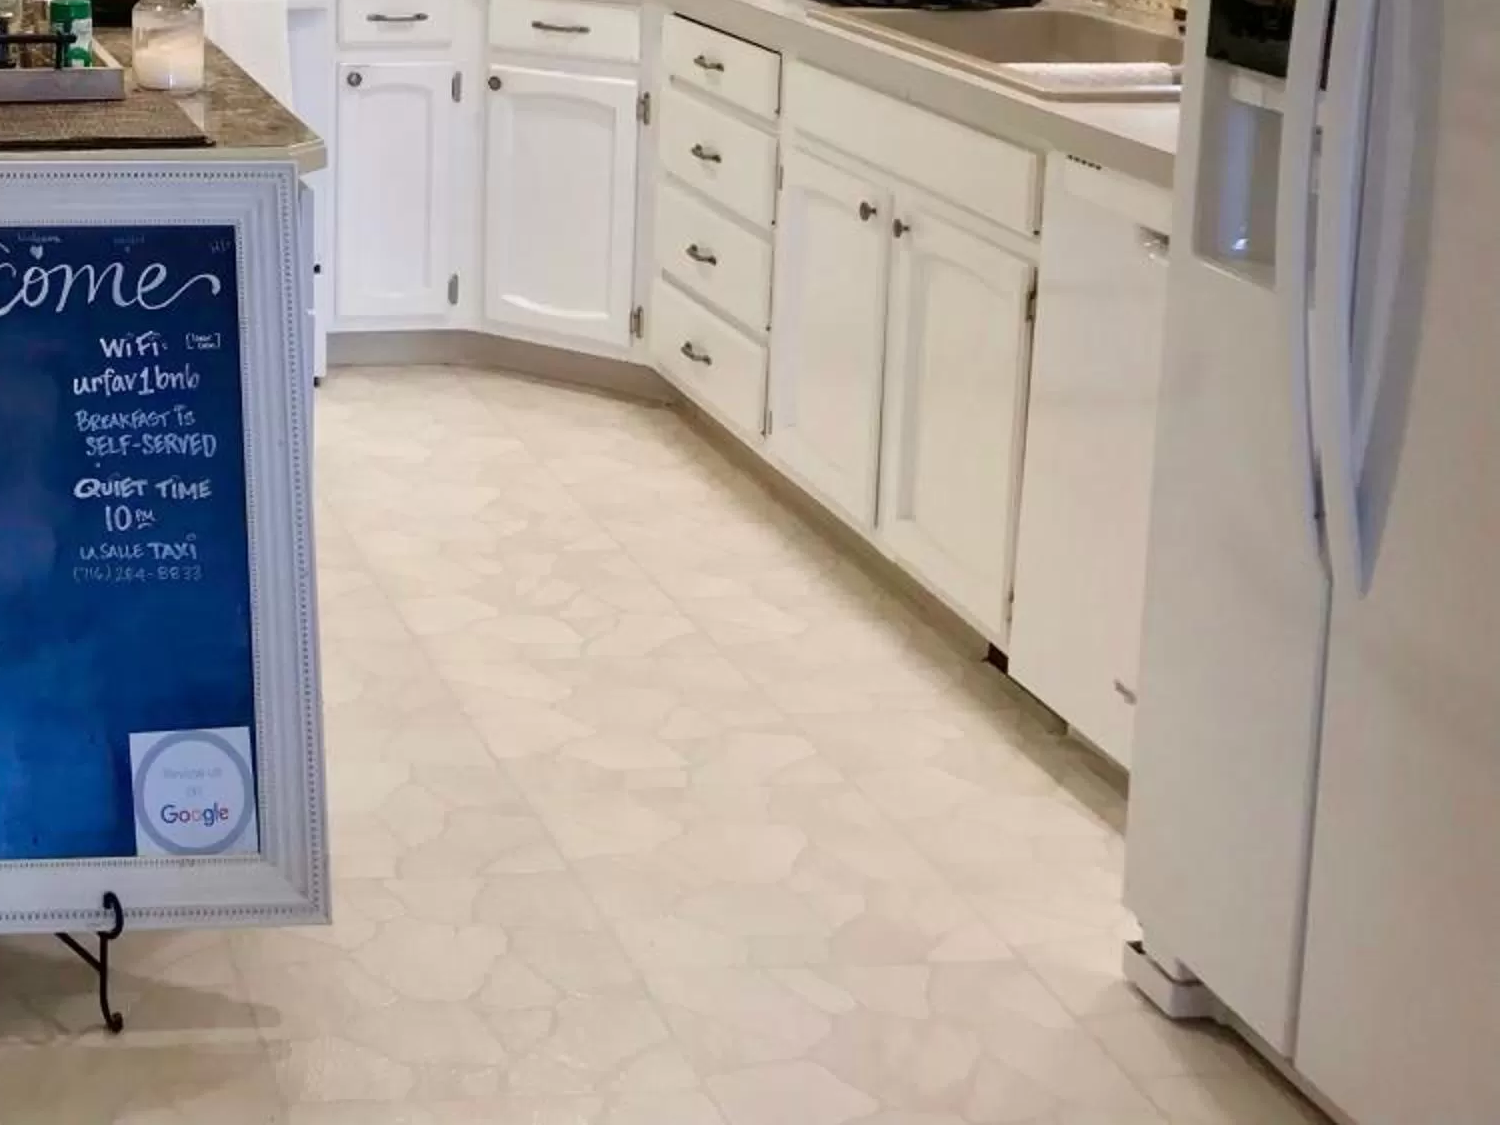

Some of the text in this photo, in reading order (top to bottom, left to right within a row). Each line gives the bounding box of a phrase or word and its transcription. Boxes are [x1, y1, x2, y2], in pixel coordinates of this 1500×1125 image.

[72, 362, 200, 397] urfav1bnb
[74, 408, 171, 432] BREAKFAST
[85, 432, 217, 458] SELF-SERVED
[73, 476, 213, 501] QUIET TIME
[161, 801, 229, 828] Google
